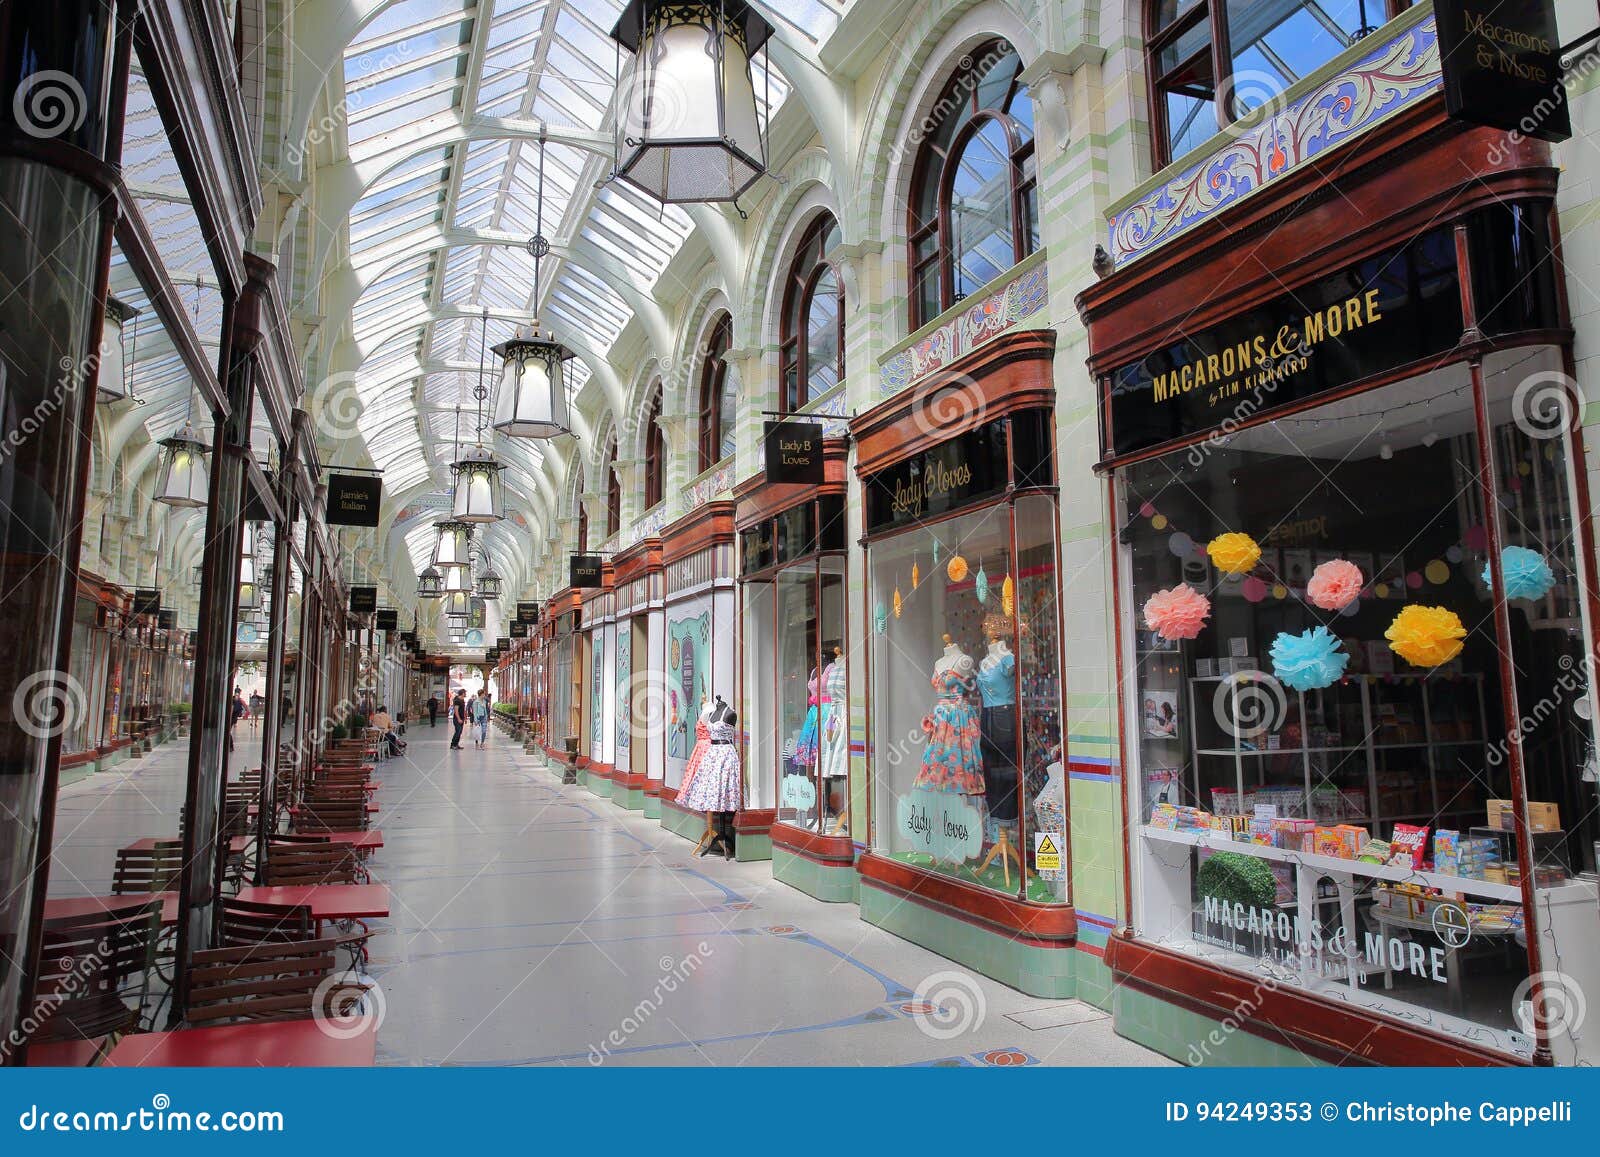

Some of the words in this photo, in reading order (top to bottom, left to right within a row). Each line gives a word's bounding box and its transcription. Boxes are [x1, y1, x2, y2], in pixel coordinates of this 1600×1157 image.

[1463, 9, 1550, 55] Macarons
[1476, 44, 1493, 70] &
[1500, 54, 1547, 84] More
[1153, 335, 1266, 403] MACARONS
[1304, 288, 1382, 347] MORE
[1218, 382, 1239, 400] TIM
[1245, 357, 1308, 390] KINNAIRD
[780, 439, 803, 453] Lady
[804, 441, 811, 451] B
[782, 454, 810, 465] Loves
[341, 500, 367, 511] Italian
[892, 476, 923, 518] Lady
[924, 465, 936, 498] B
[937, 460, 972, 492] loves
[907, 804, 932, 845] Lady
[943, 810, 969, 841] loves
[1204, 896, 1322, 950] MACARONS
[1365, 932, 1448, 983] MORE
